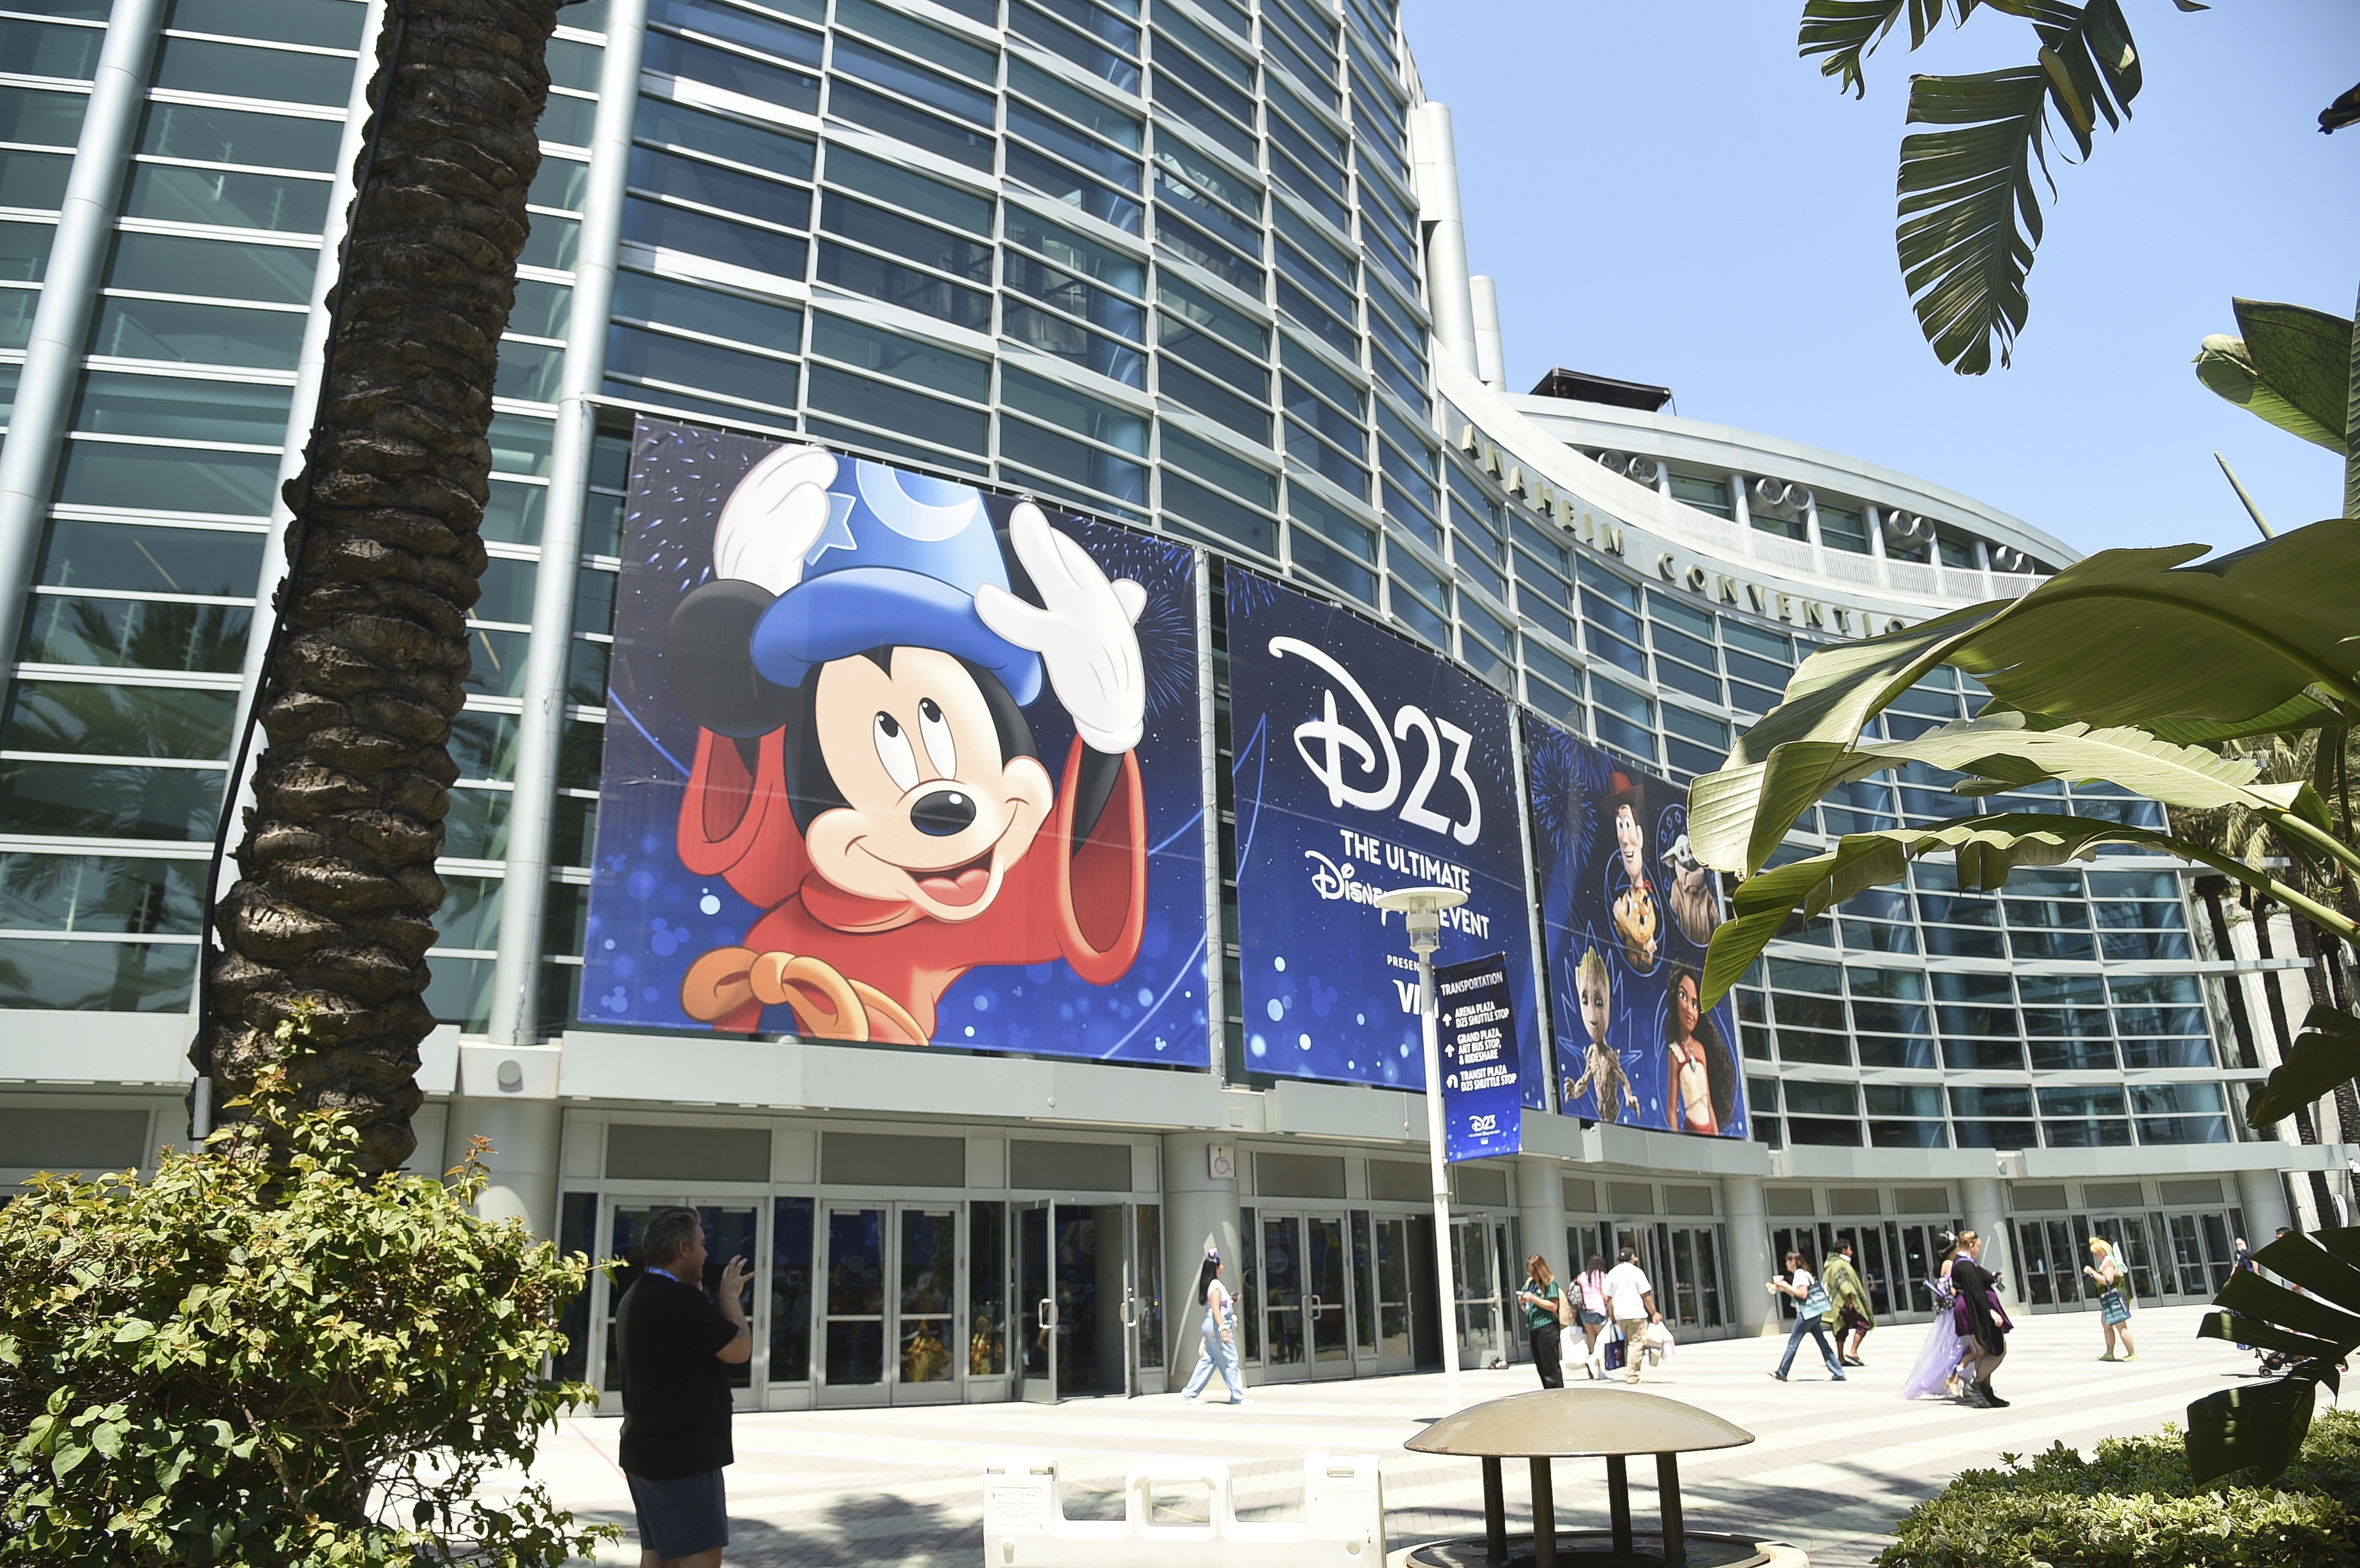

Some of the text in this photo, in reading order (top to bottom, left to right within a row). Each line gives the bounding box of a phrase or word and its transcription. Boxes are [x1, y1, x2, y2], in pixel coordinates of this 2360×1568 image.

[1462, 423, 1906, 638] ANAHEIM CONVENTIO
[1269, 637, 1481, 845] D23
[1340, 829, 1471, 894] THE ULTIMATE
[1439, 906, 1490, 940] EVENT
[1387, 954, 1420, 972] PRESEN
[1441, 971, 1504, 996] TRANSPORTATION
[1392, 979, 1439, 1019] VI
[1455, 1000, 1495, 1018] ARENA PLAZA
[1456, 1008, 1509, 1029] D23 SHUTTLE STOP
[1457, 1027, 1502, 1044] GRAND PLAZA,
[1458, 1043, 1471, 1055] ART
[1472, 1041, 1484, 1052] BUS
[1464, 1049, 1499, 1064] RIDESHARE
[1460, 1064, 1508, 1081] TRANSIT PLAZA
[1461, 1073, 1517, 1092] D23 SHUTTLE STOP
[1469, 1114, 1496, 1133] D23
